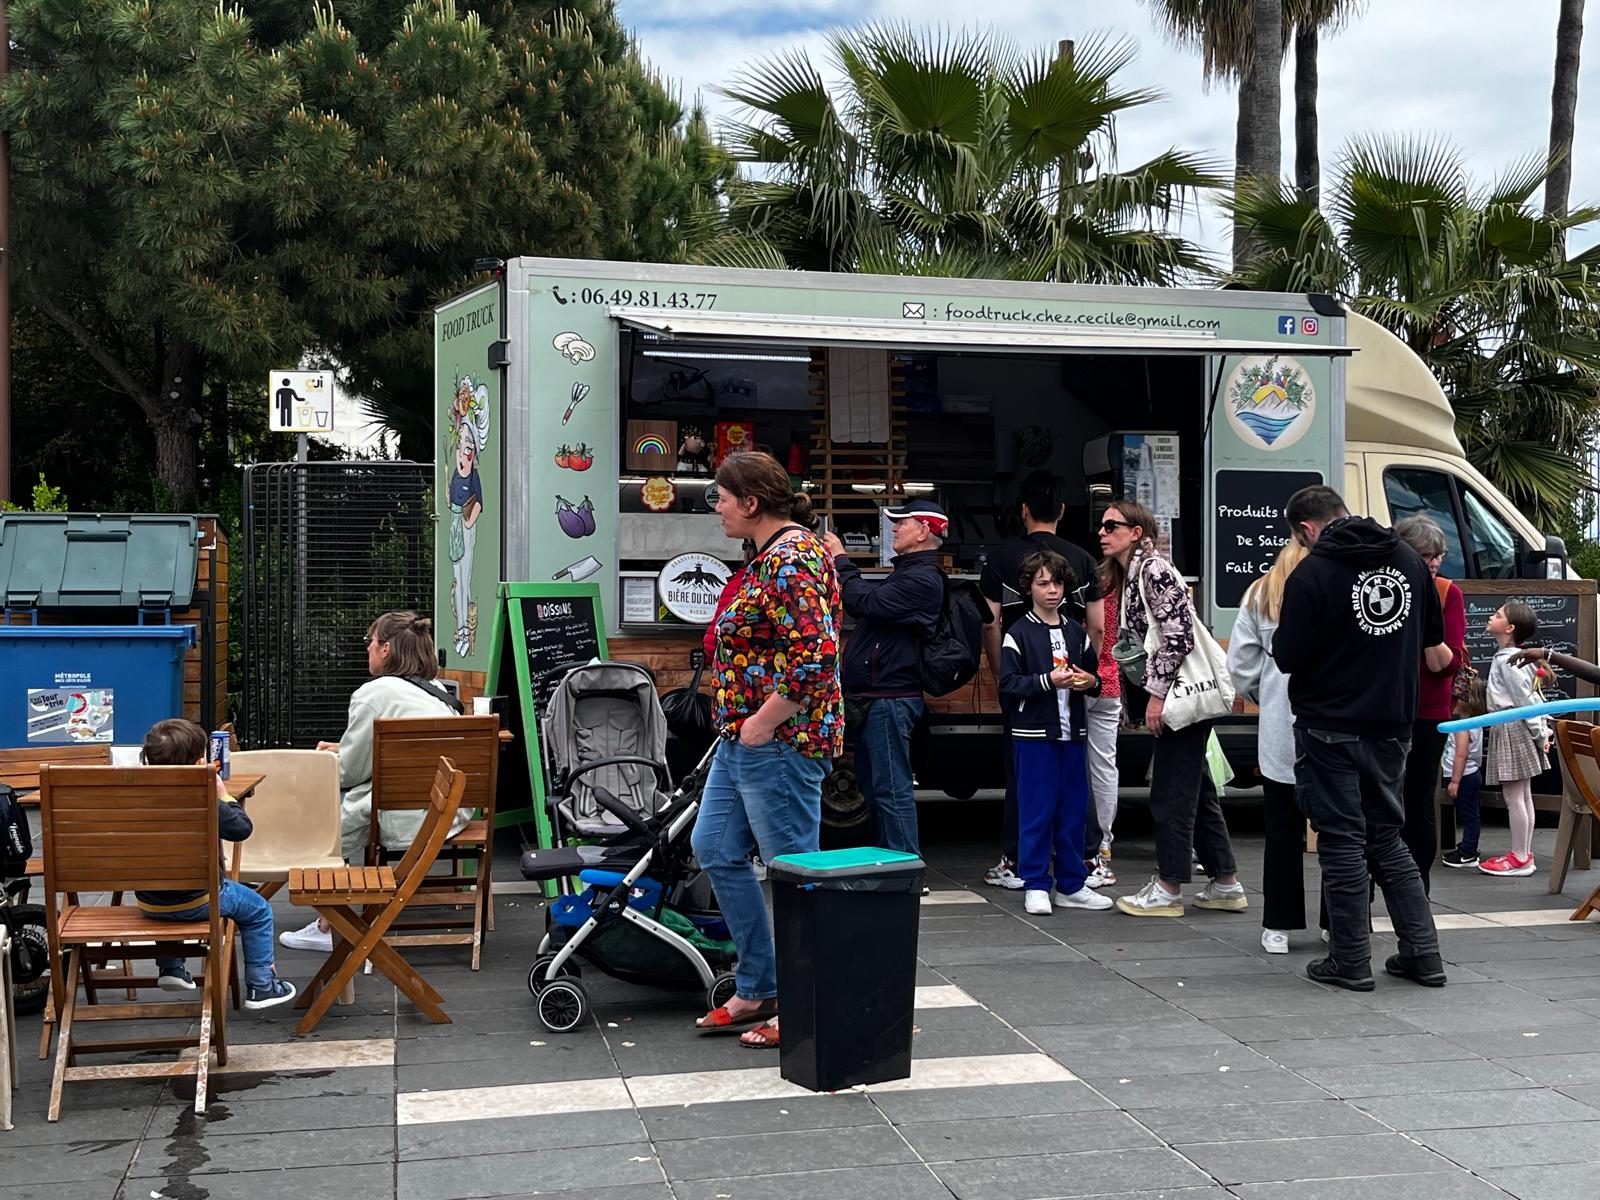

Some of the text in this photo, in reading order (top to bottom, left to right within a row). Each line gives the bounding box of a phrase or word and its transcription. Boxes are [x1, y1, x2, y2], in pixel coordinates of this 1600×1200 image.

[581, 287, 718, 310] 06.49.81.43.77
[442, 303, 495, 342] FOOD TRUCK
[945, 305, 1221, 330] foodtruck.chez.cecile@gmail.com
[646, 484, 670, 493] Chupa
[646, 492, 670, 505] Chups
[1218, 504, 1278, 518] Produits
[1236, 534, 1291, 547] De Saiso
[1225, 561, 1254, 574] Fait
[1386, 566, 1407, 584] LIFE
[1364, 577, 1396, 594] BMW
[668, 588, 720, 605] BIÈRE DU COM
[1351, 584, 1361, 611] RIDE
[1184, 678, 1218, 696] PALM
